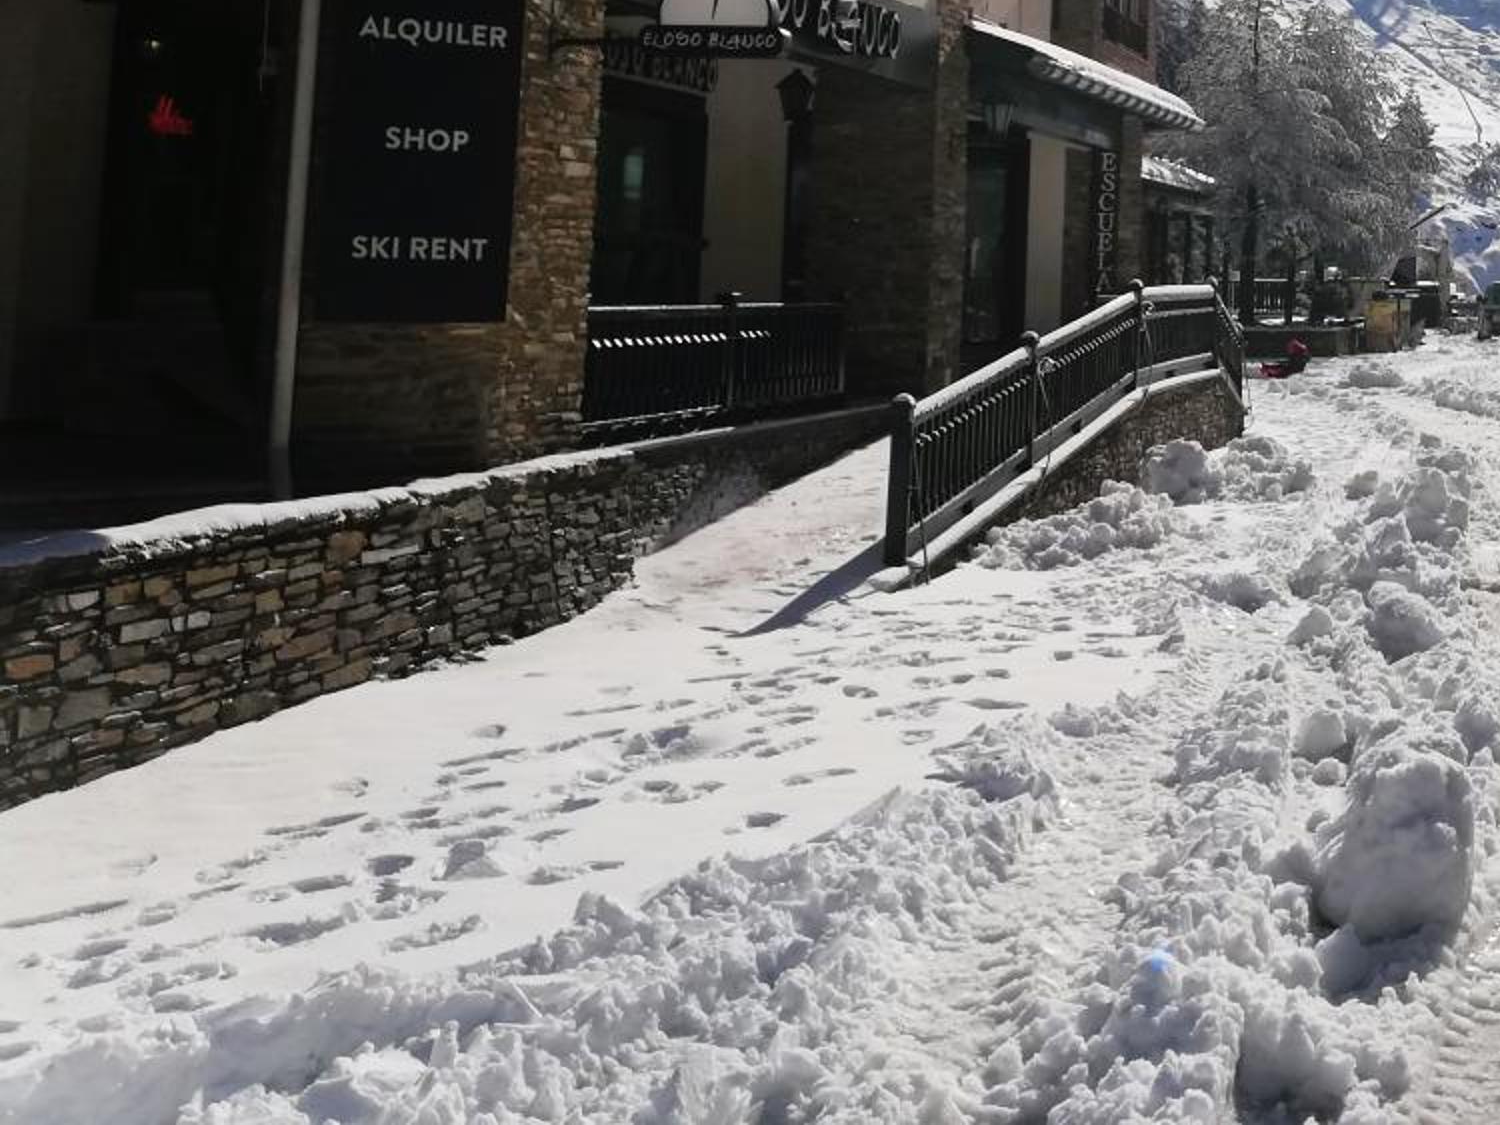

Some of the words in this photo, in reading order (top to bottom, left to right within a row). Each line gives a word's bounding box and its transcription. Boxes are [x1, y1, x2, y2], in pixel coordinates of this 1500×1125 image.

[359, 15, 508, 48] ALQUILER
[385, 126, 469, 152] SHOP
[351, 235, 400, 260] SKI
[408, 237, 488, 261] RENT
